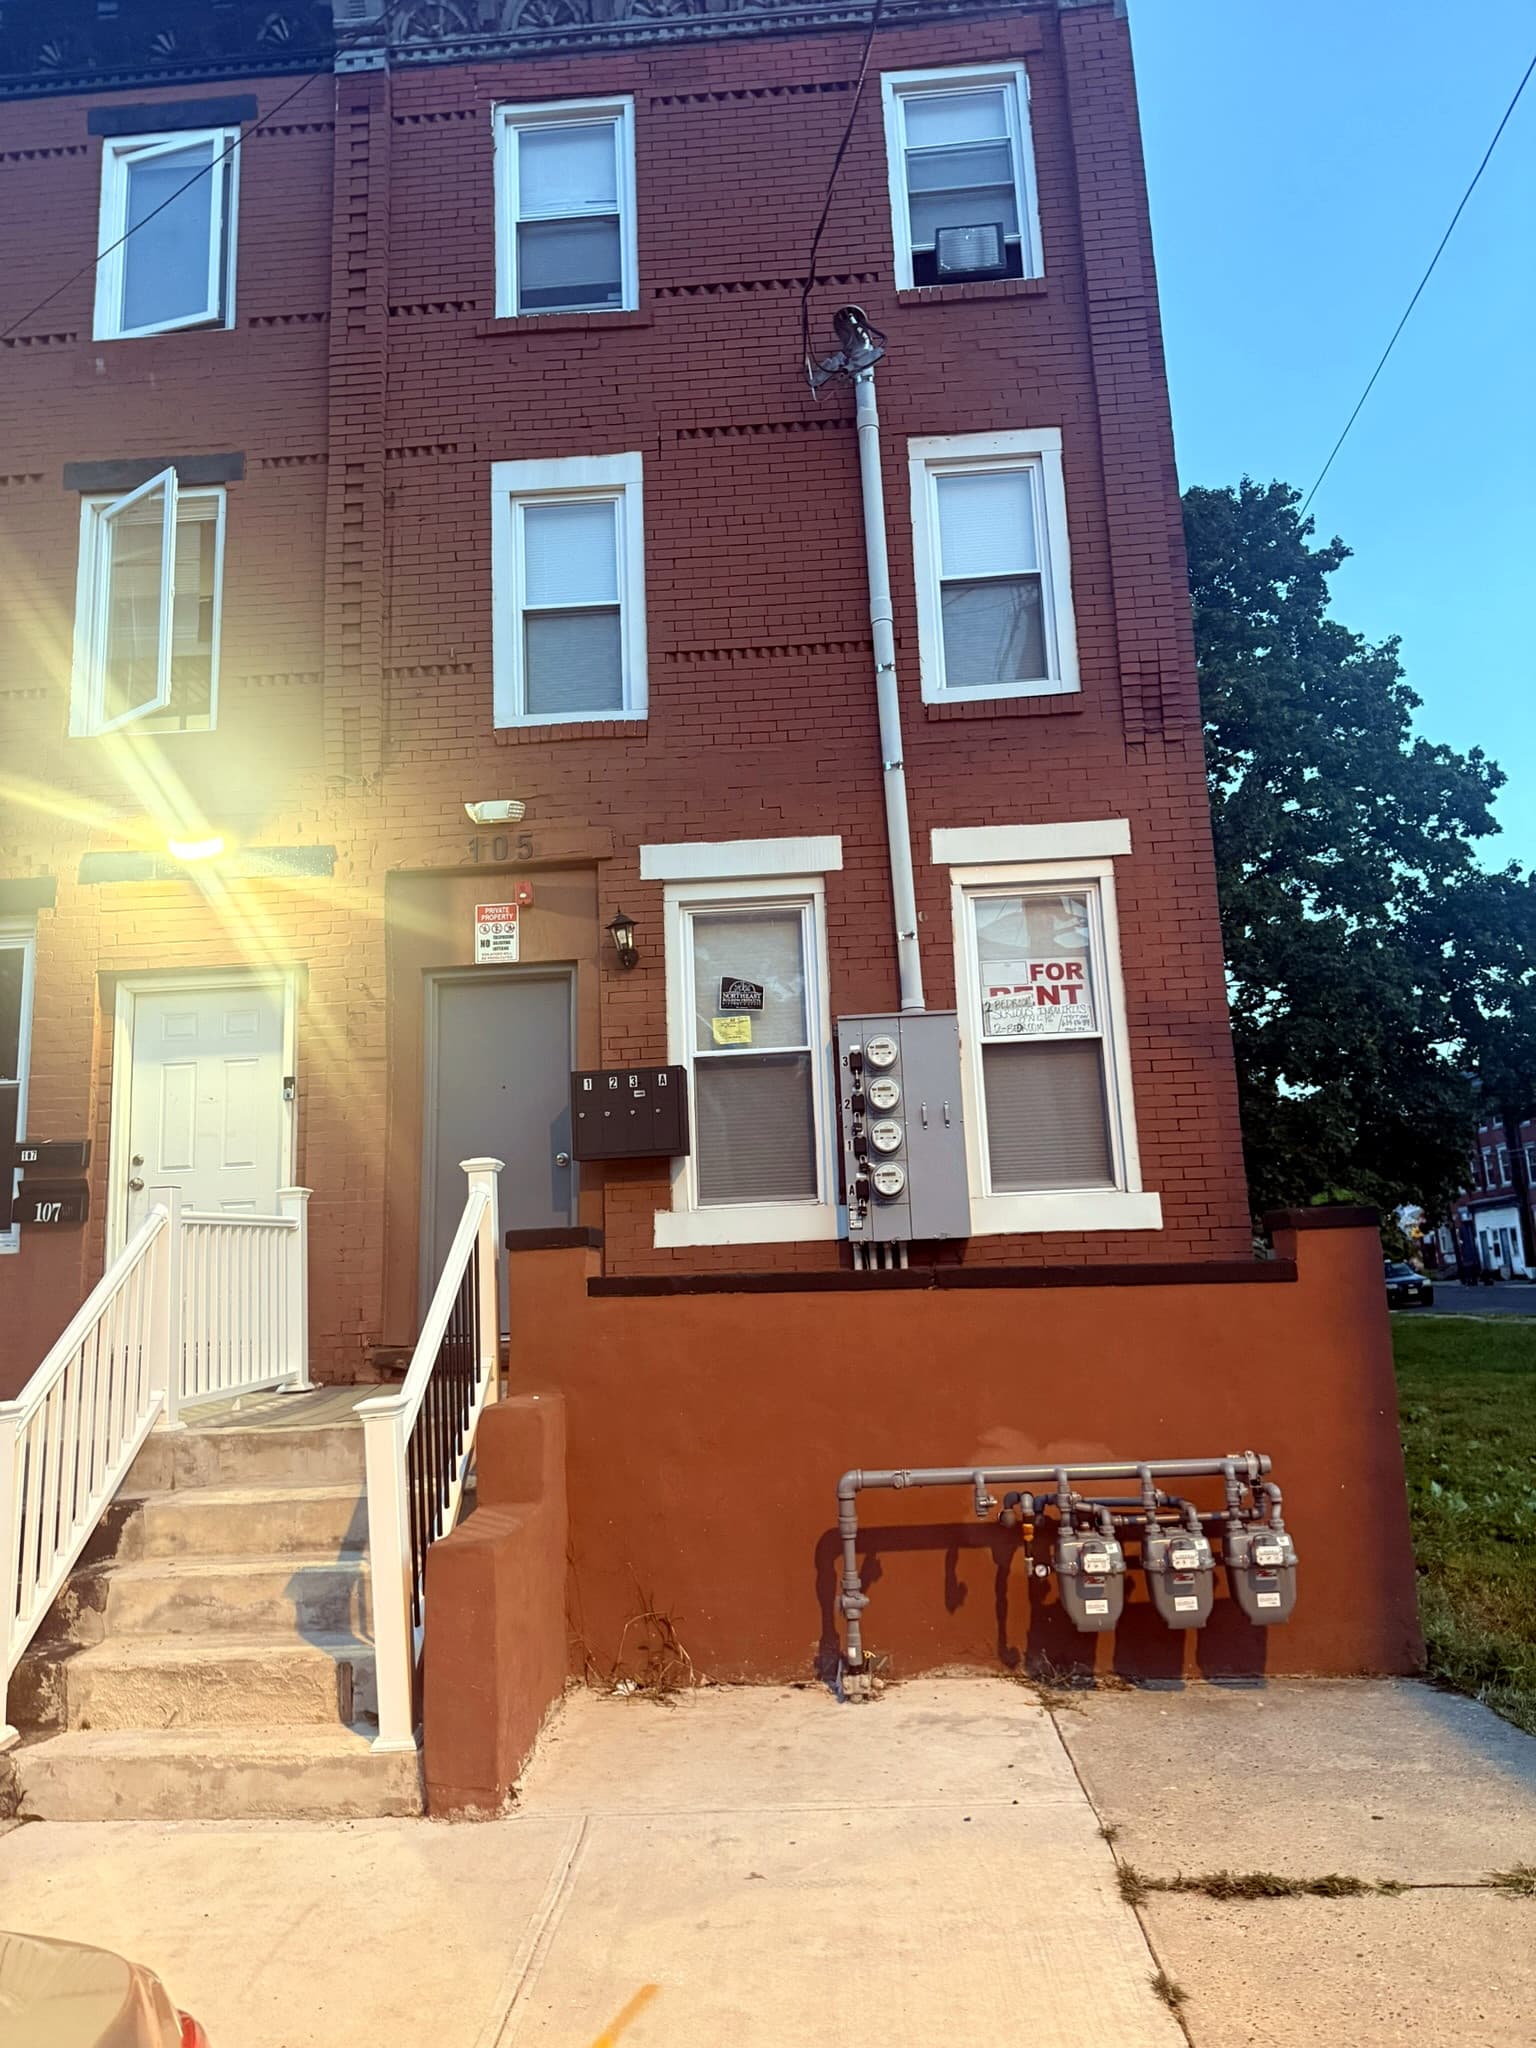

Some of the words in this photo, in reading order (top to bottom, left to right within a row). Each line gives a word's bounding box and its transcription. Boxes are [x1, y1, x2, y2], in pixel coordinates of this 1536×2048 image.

[467, 832, 533, 863] 105
[484, 906, 509, 914] PRIVATE
[481, 913, 514, 921] PROPERTY
[480, 939, 491, 948] NO
[1030, 962, 1085, 981] FOR
[842, 1056, 848, 1067] 3
[610, 1078, 616, 1088] 2
[630, 1076, 637, 1087] 3
[659, 1075, 666, 1086] A
[844, 1099, 850, 1109] 2
[21, 1150, 37, 1161] 107
[849, 1185, 854, 1196] A
[33, 1202, 62, 1222] 107
